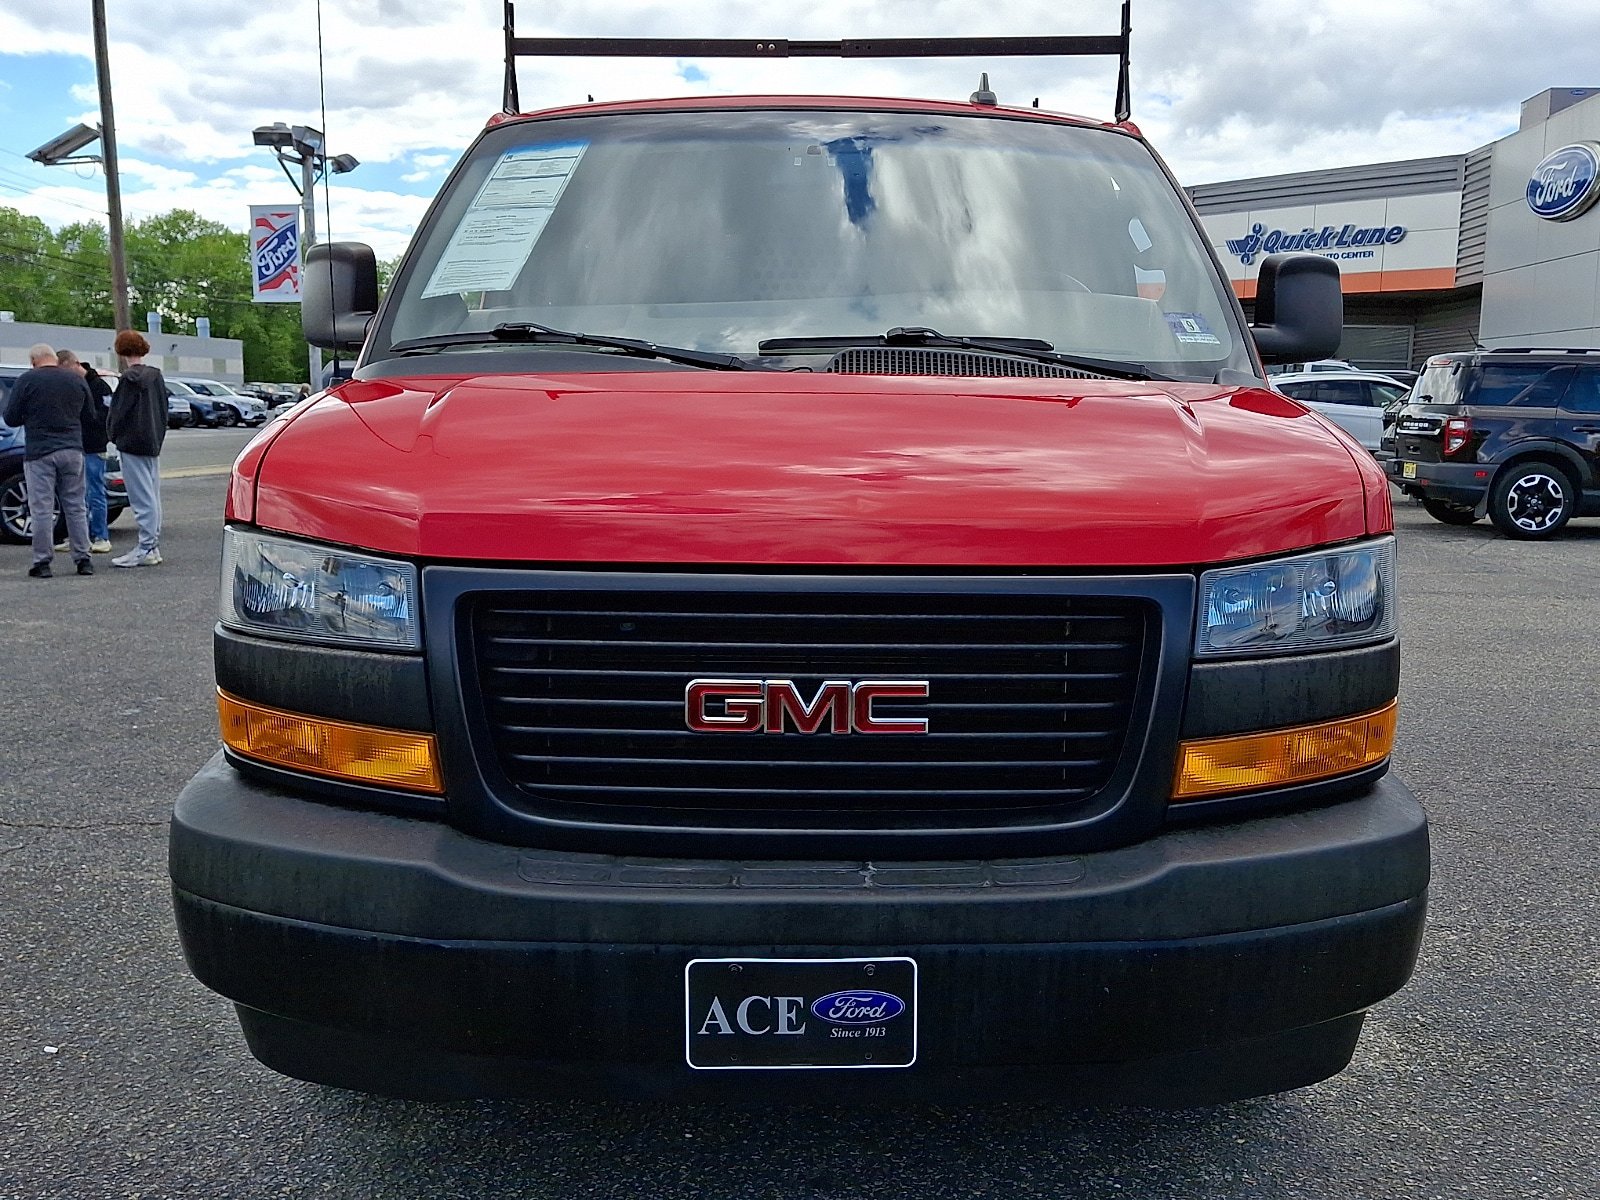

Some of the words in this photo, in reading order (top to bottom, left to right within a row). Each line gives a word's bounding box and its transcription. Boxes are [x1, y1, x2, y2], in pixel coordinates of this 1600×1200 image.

[1536, 162, 1578, 207] Ford
[257, 231, 297, 275] Ford
[1262, 226, 1334, 253] Quick
[1335, 224, 1406, 247] Lane
[1341, 251, 1374, 259] CENTER
[685, 679, 930, 735] GMC
[697, 996, 806, 1035] ACE
[829, 996, 886, 1019] Ford
[830, 1027, 861, 1038] Since
[864, 1027, 886, 1037] 1913
